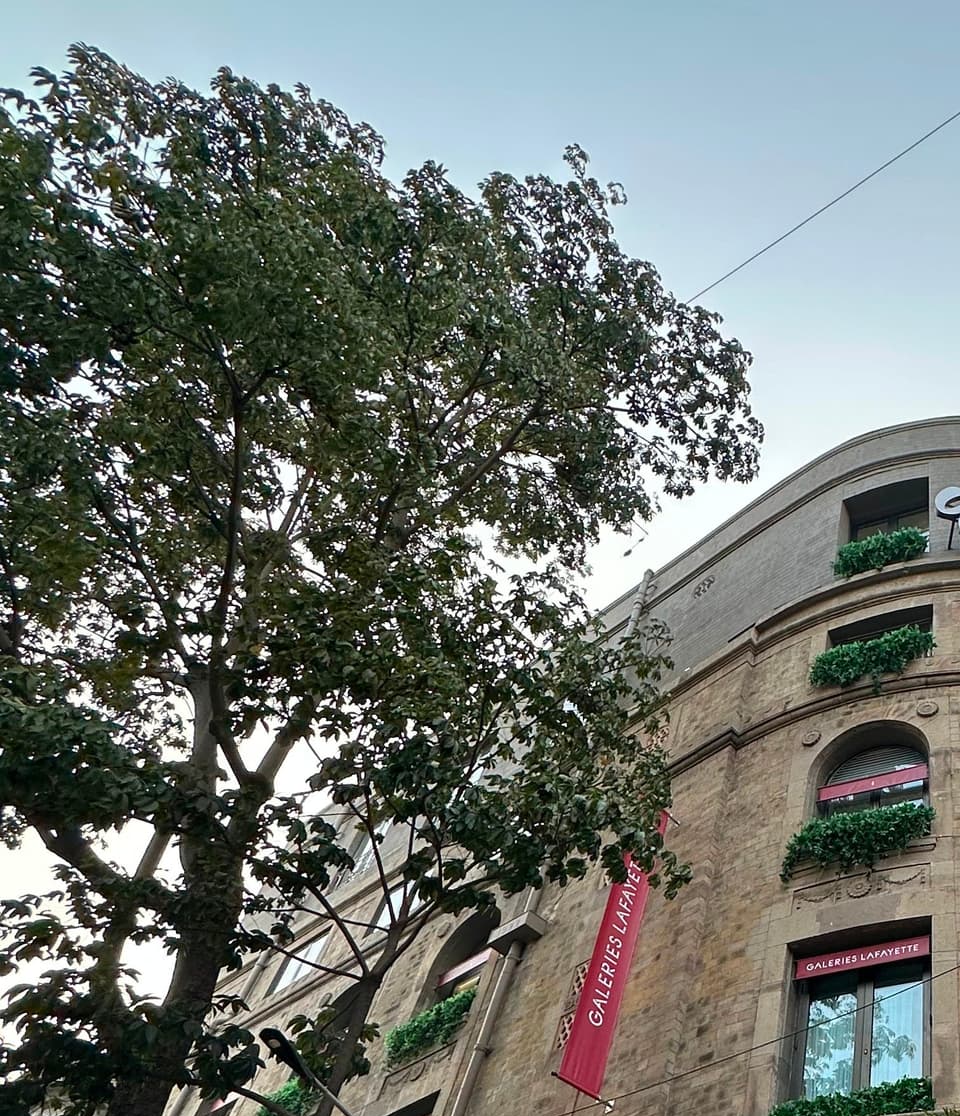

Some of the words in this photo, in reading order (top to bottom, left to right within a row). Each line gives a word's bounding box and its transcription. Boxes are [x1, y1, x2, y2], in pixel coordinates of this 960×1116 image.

[588, 935, 623, 1028] GALERIES
[612, 860, 643, 936] LAFAYET
[806, 955, 858, 972] GALERIES
[860, 943, 920, 962] LAFAYETTE
